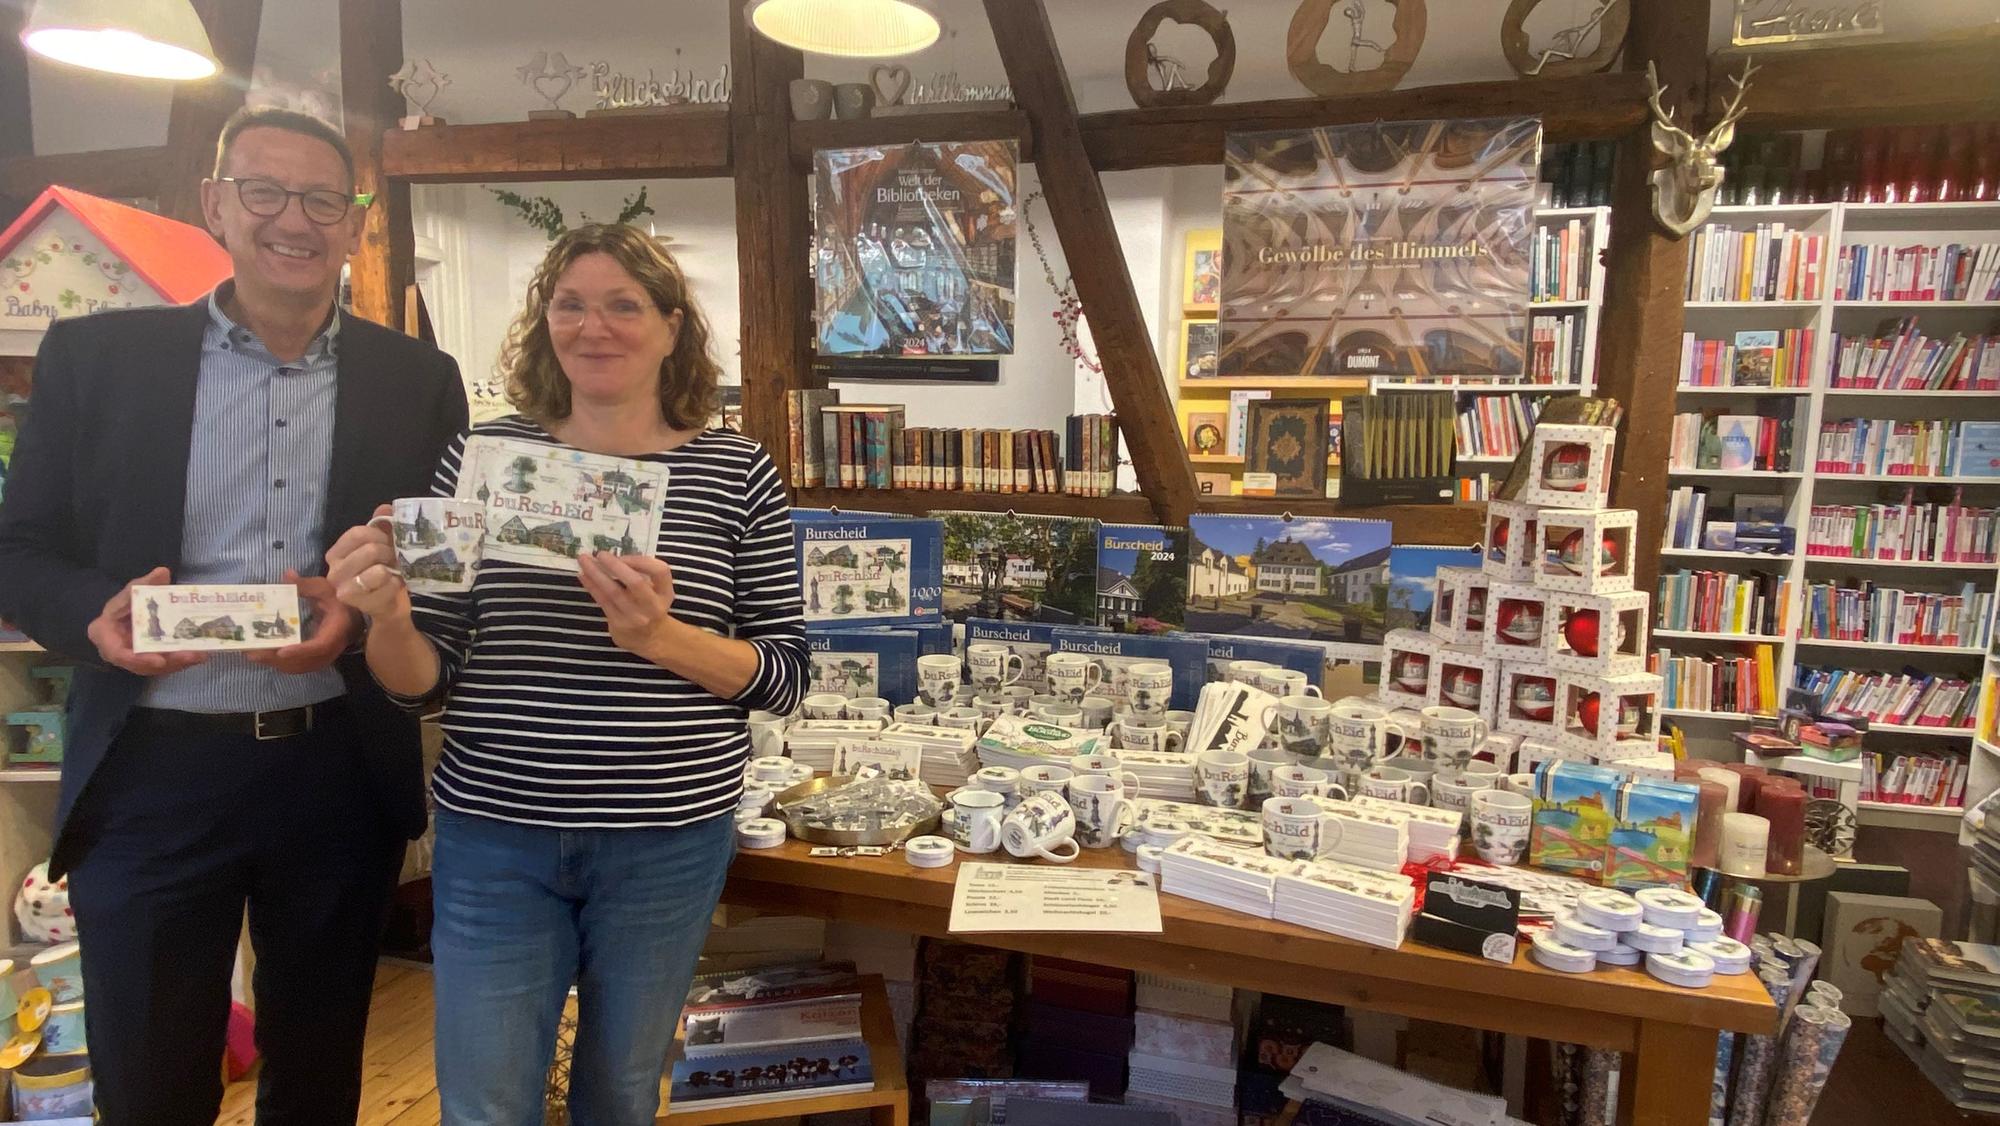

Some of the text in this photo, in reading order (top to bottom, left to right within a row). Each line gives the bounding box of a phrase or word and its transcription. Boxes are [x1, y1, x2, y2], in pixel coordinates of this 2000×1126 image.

[898, 174, 943, 186] Welt der
[876, 187, 960, 203] Bibliotheken
[1258, 239, 1488, 264] Gewölbe des Himmels
[5, 296, 58, 322] Baby
[903, 337, 925, 347] 2024
[1347, 355, 1380, 368] DUMONT
[805, 526, 867, 540] Burscheid
[1104, 539, 1164, 551] Burscheid
[1150, 551, 1176, 562] 2024
[911, 586, 942, 598] 1000
[973, 626, 1031, 641] Burscheid
[1060, 639, 1121, 655] Burscheid
